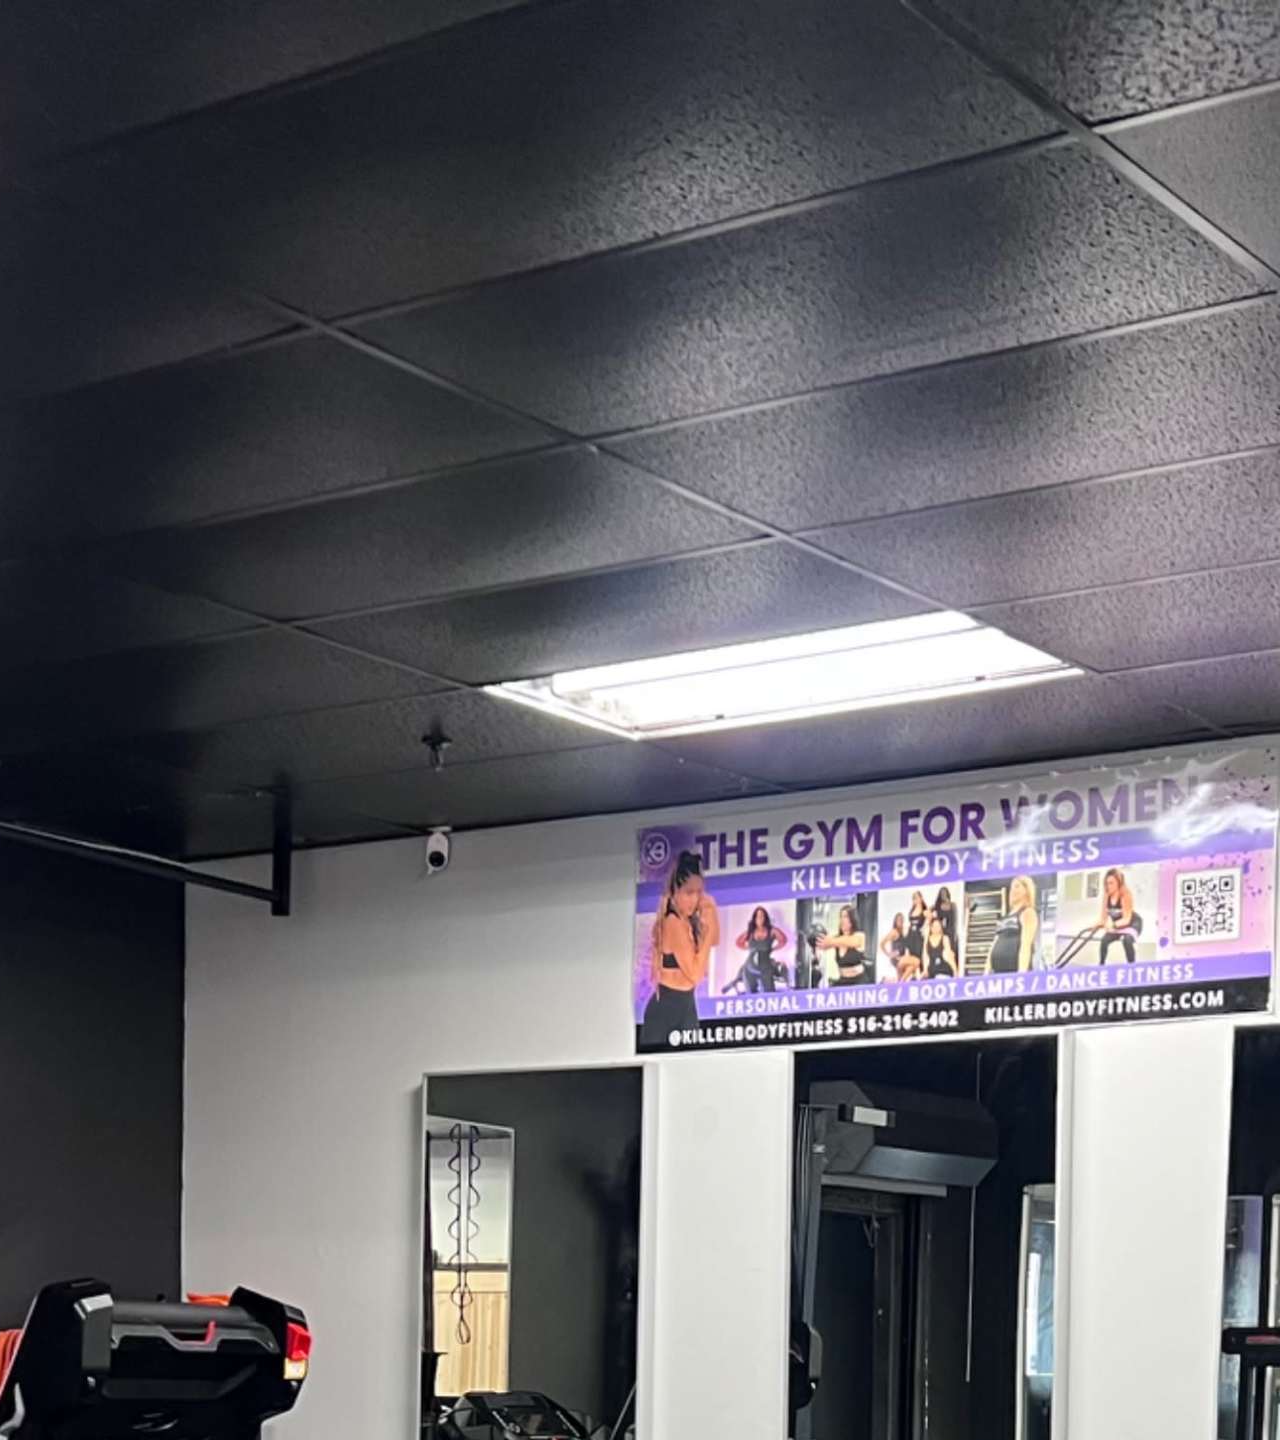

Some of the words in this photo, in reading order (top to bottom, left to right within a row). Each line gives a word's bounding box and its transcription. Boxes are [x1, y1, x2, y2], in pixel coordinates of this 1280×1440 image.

[695, 828, 769, 870] THE
[784, 814, 883, 860] GYM
[900, 803, 986, 848] FOR
[791, 864, 881, 892] KILLER
[893, 852, 969, 882] BODY
[981, 837, 1101, 872] FITNESS
[716, 997, 800, 1016] PERSONAL
[806, 987, 889, 1009] TRAINING
[910, 982, 958, 1001] BOOT
[964, 977, 1025, 997] CAMPS
[1046, 969, 1109, 990] DANCE
[1116, 963, 1195, 985] FITNESS
[668, 1018, 844, 1047] @KILLERBODYFITNESS
[847, 1009, 959, 1034] 516-216-5402
[984, 990, 1225, 1024] KILLERBODYFITNESS.COM
